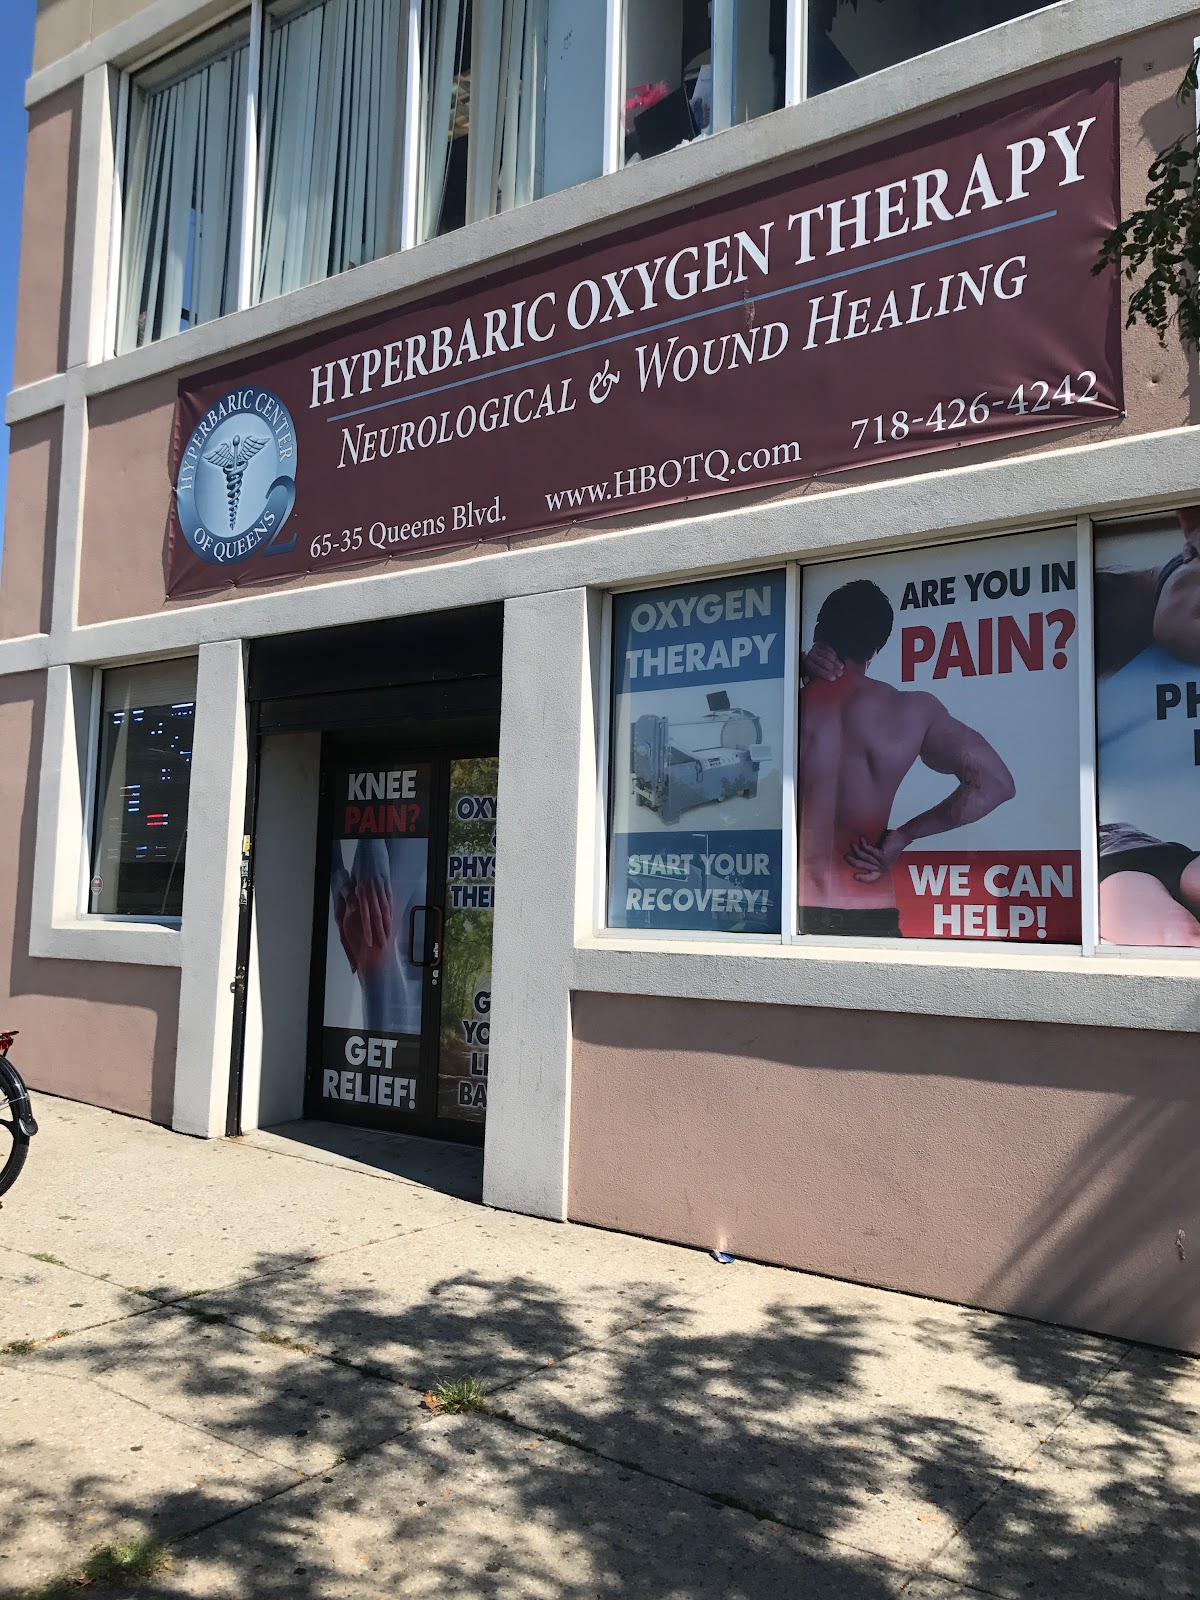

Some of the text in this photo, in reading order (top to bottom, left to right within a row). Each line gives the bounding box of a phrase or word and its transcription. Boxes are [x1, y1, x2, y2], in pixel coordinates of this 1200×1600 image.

[309, 116, 1097, 408] HYPERBARIC OXYGEN THERAPY
[336, 255, 1028, 469] NEUROLOGICAL & WOUND HEALING
[850, 370, 1100, 451] 718-426-4242
[180, 389, 294, 490] HYPERBARIC CENTER
[544, 440, 803, 512] www.HBOTQ.com
[193, 509, 277, 563] OF QUEENS
[309, 496, 507, 559] 65-35 Queens Blvd.
[630, 585, 773, 633] OXYGEN
[899, 560, 1077, 611] ARE YOU IN
[625, 633, 778, 680] THERAPY
[900, 608, 1077, 684] PAIN?
[347, 769, 418, 801] KNEE
[343, 803, 422, 834] PAIN?
[627, 853, 771, 877] START YOUR
[907, 864, 1074, 898] WE CAN
[625, 888, 770, 914] RECOVERY!
[932, 903, 1047, 939] HELP!
[344, 1035, 399, 1070] GET
[322, 1068, 417, 1110] RELIEF!
